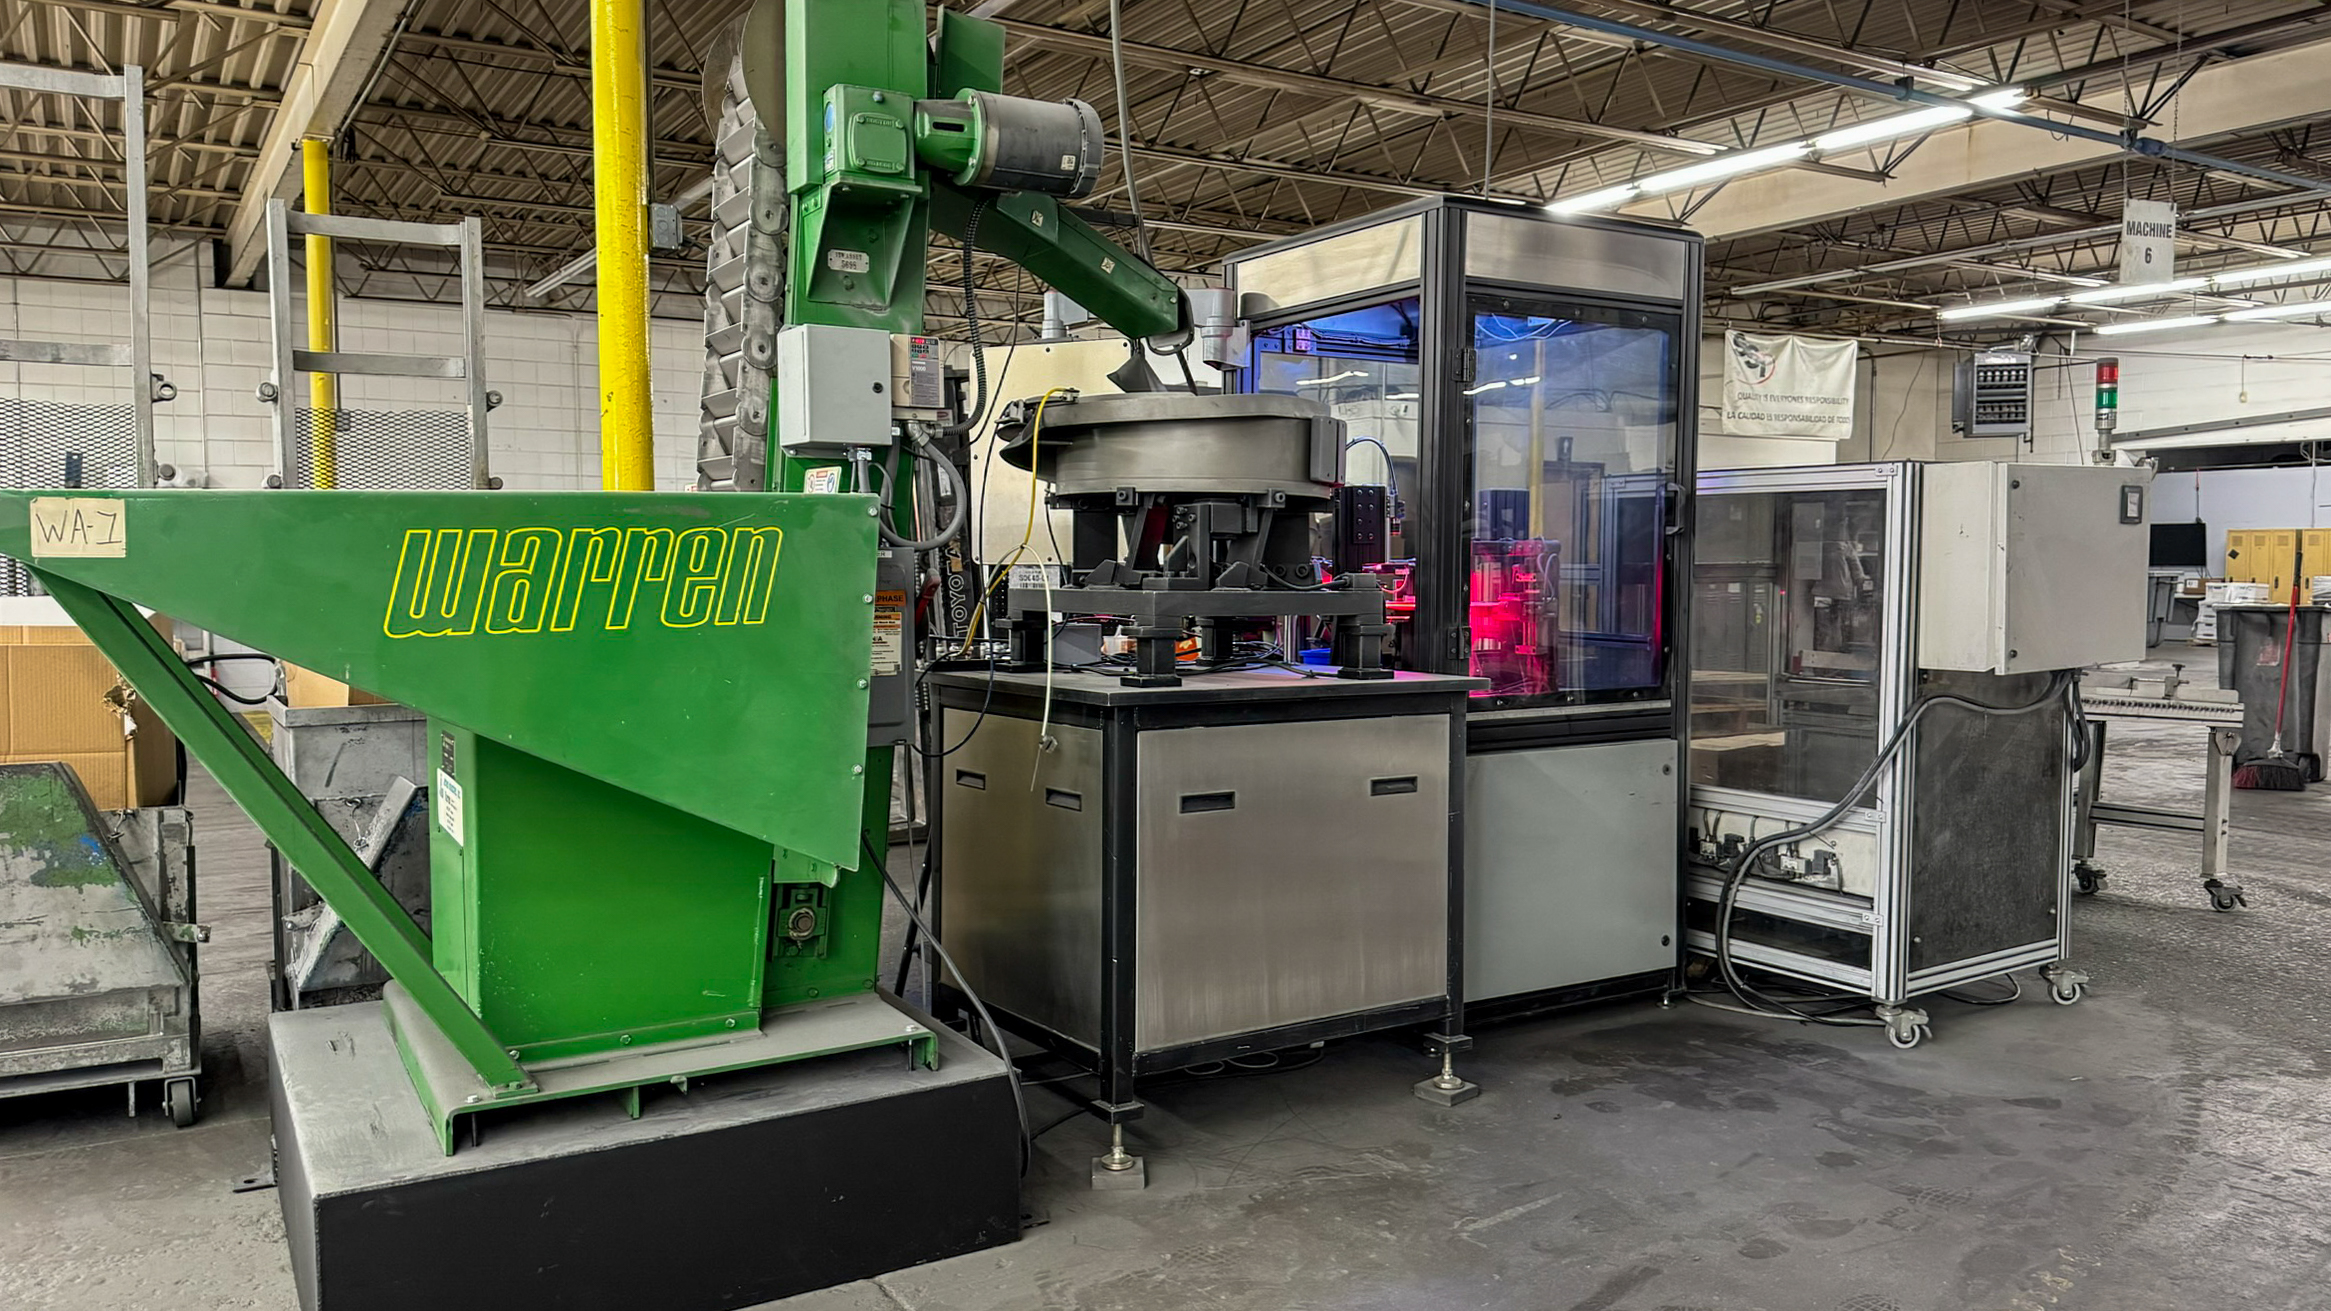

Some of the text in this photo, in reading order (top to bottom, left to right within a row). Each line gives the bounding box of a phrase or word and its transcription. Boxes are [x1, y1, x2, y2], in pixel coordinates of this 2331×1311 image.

[2126, 221, 2173, 239] MACHINE
[2144, 247, 2153, 264] 6
[1738, 392, 1762, 402] QUALITY
[1763, 394, 1769, 402] IS
[1805, 397, 1849, 405] RESPONSIBILITY
[1727, 412, 1736, 420] LA
[1738, 412, 1766, 421] CALIDAD
[1766, 413, 1773, 421] ES
[1827, 415, 1836, 424] DE
[876, 594, 904, 603] PHASE
